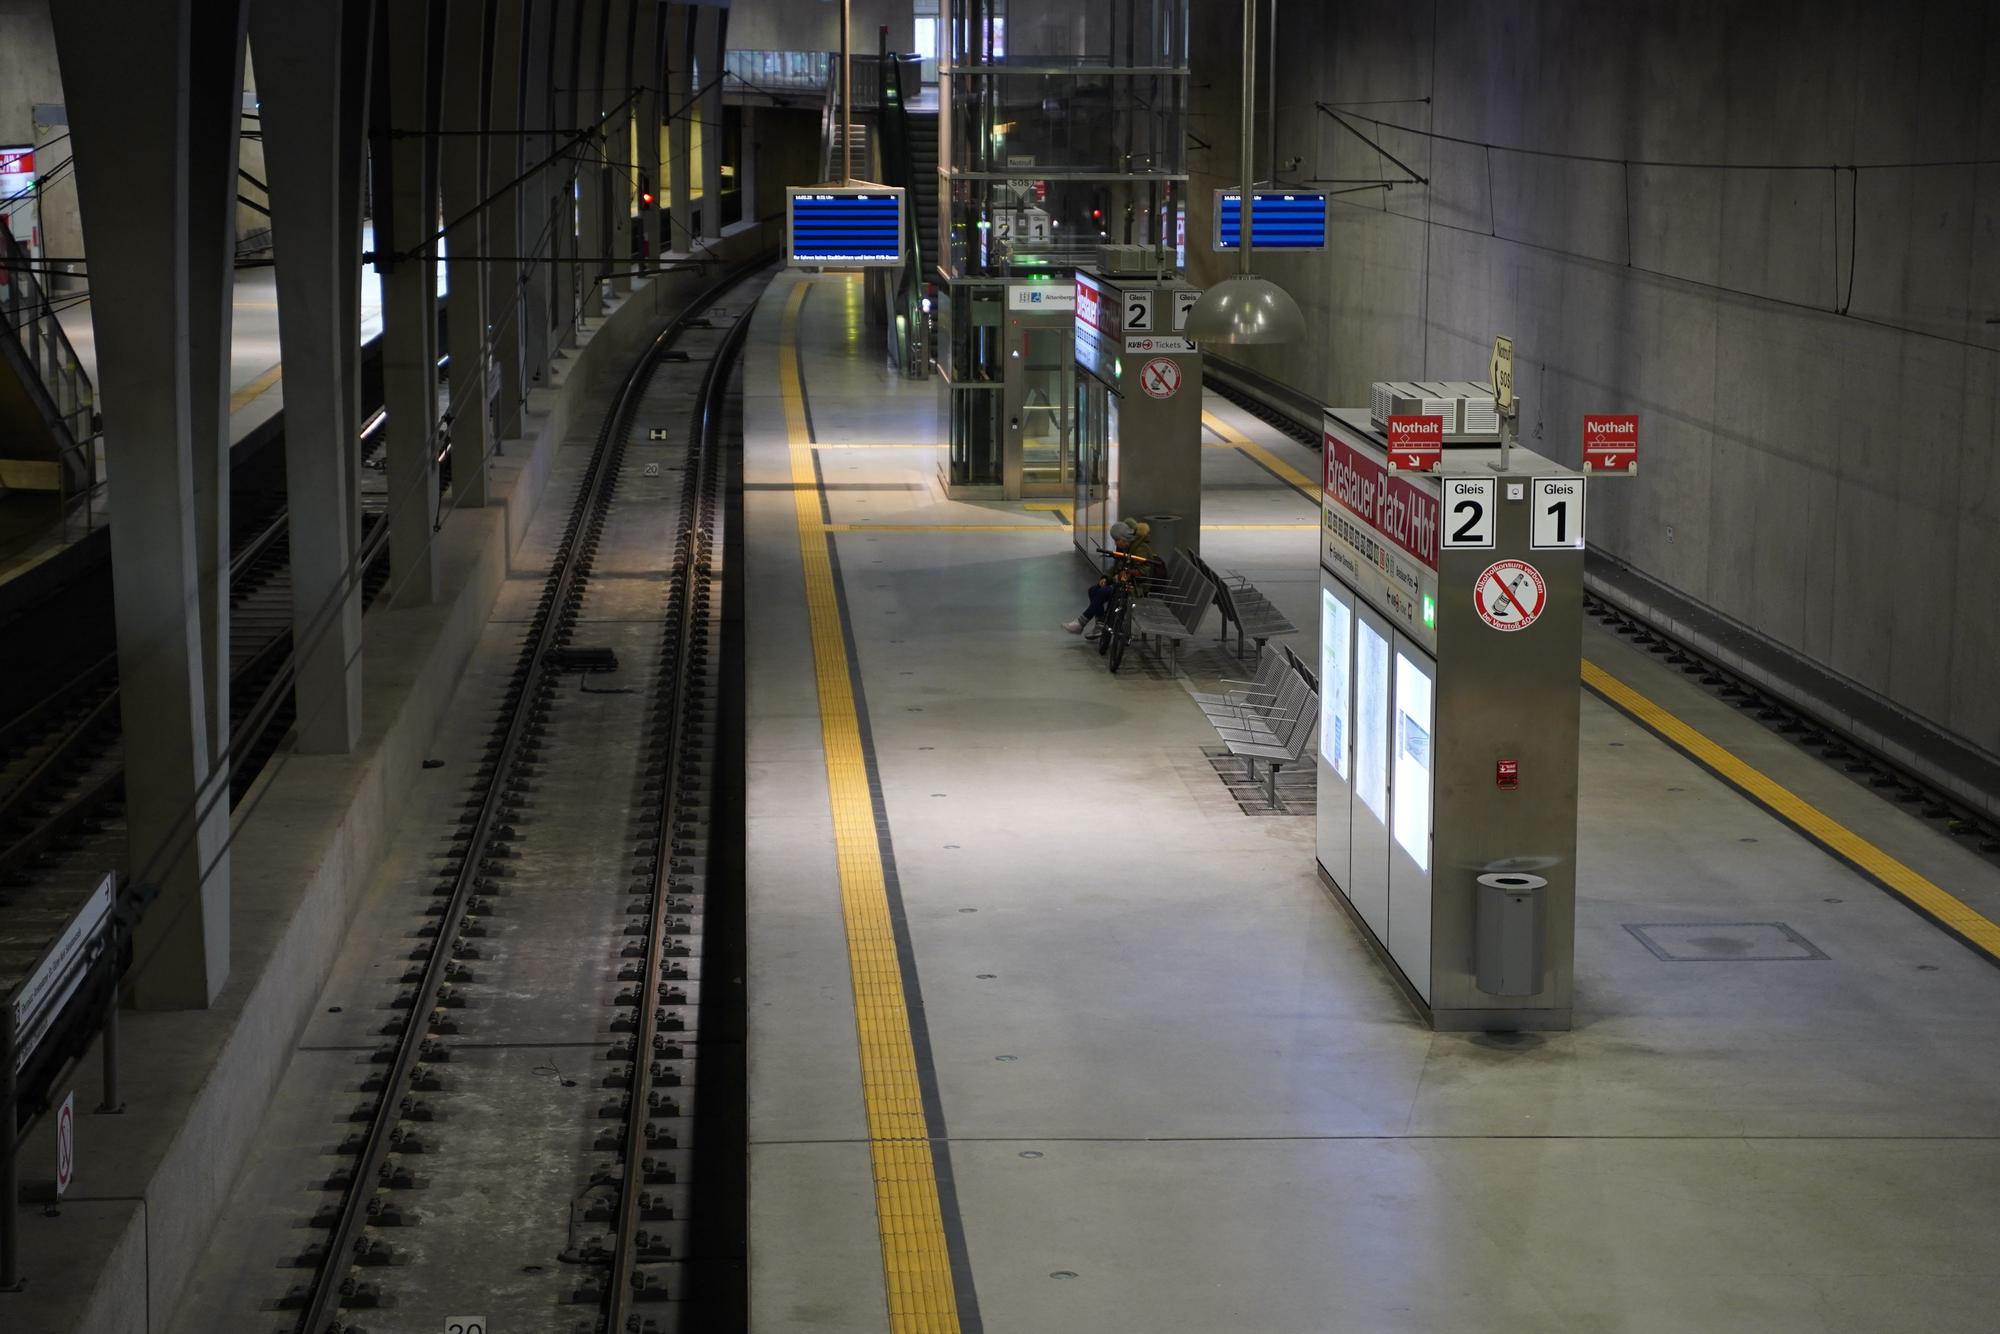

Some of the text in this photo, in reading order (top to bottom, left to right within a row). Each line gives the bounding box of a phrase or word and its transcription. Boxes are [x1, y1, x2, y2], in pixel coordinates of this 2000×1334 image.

[998, 223, 1010, 241] 2
[1035, 223, 1043, 241] 1
[1128, 303, 1147, 328] 2
[1127, 341, 1181, 349] KVB Tickets
[1497, 341, 1511, 361] Notruf
[1499, 370, 1511, 389] SOS
[1392, 421, 1440, 434] Nothalt
[1587, 421, 1635, 434] Nothalt
[646, 464, 658, 474] 20
[1454, 483, 1484, 495] Gleis
[1544, 483, 1574, 495] Gleis
[1327, 440, 1376, 519] Breslauer
[1376, 471, 1436, 561] Platz/Hbf
[1452, 500, 1484, 542] 2
[1547, 501, 1567, 542] 1
[1477, 562, 1544, 594] Alkoholkonsum verboten
[1482, 611, 1536, 630] bei Verstoß 40€
